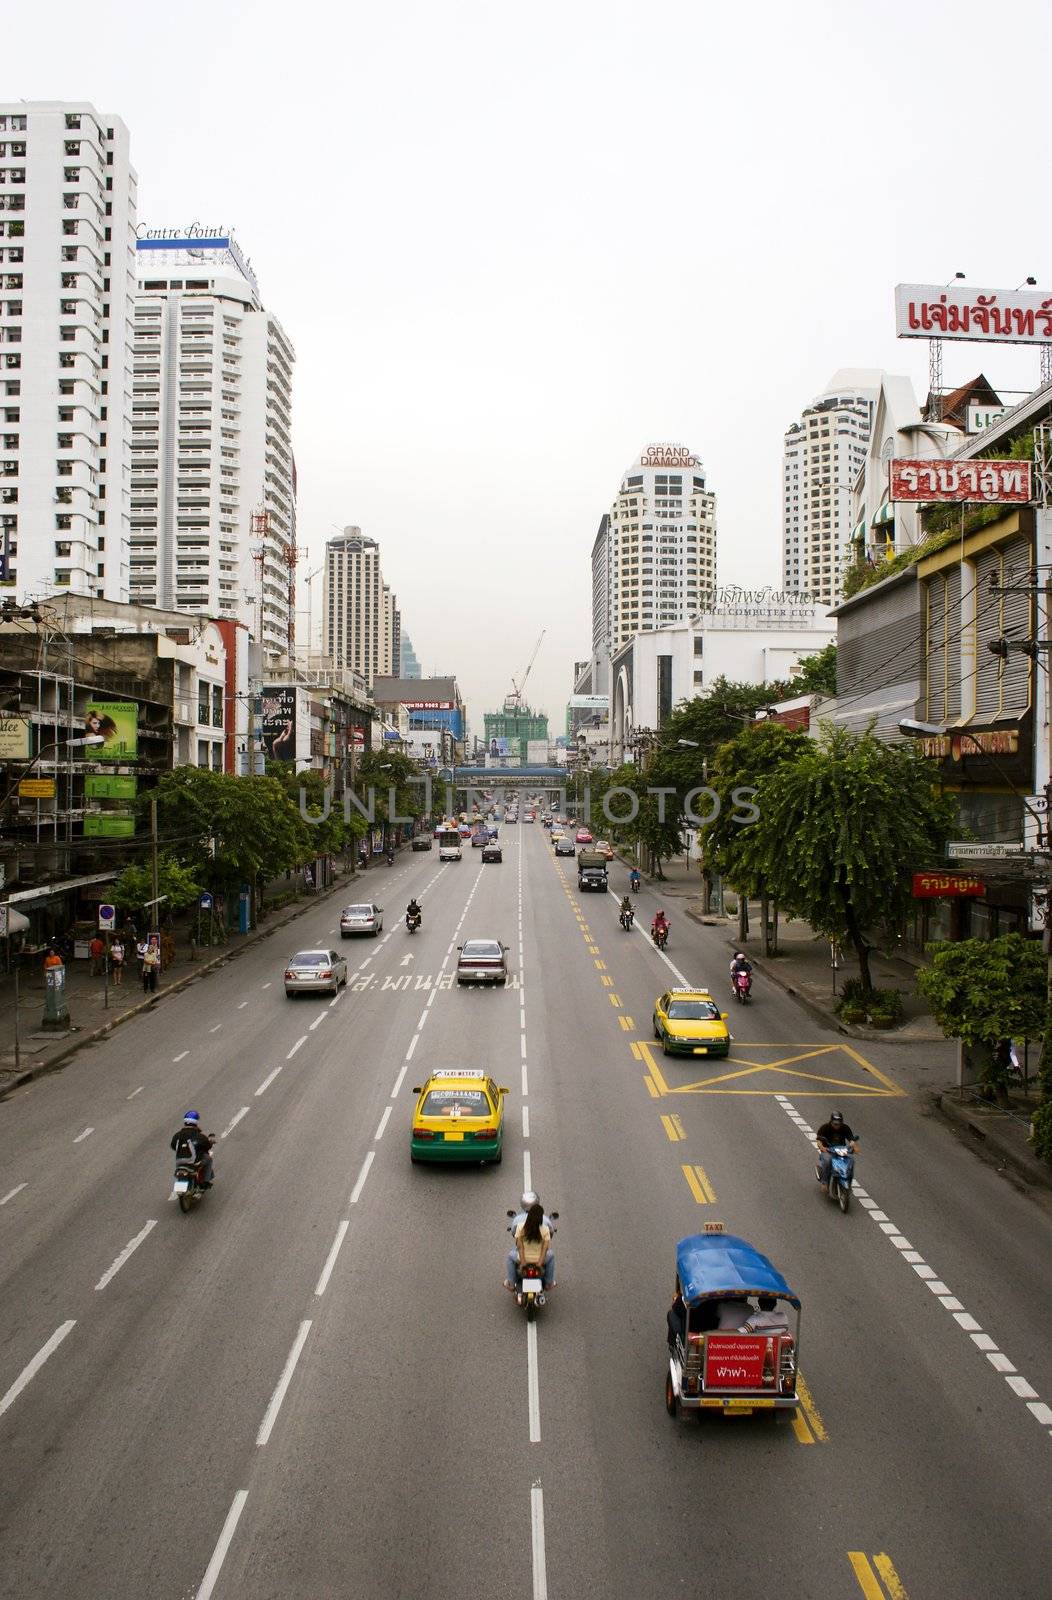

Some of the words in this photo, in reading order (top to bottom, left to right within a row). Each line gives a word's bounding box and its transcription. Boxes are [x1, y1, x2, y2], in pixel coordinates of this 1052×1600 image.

[135, 222, 181, 240] Centre
[184, 221, 225, 239] Point
[647, 447, 690, 457] GRAND
[640, 456, 696, 467] DIAMOND
[728, 608, 786, 616] COMPUTER
[791, 609, 817, 617] CITY
[704, 1223, 723, 1231] TAXI
